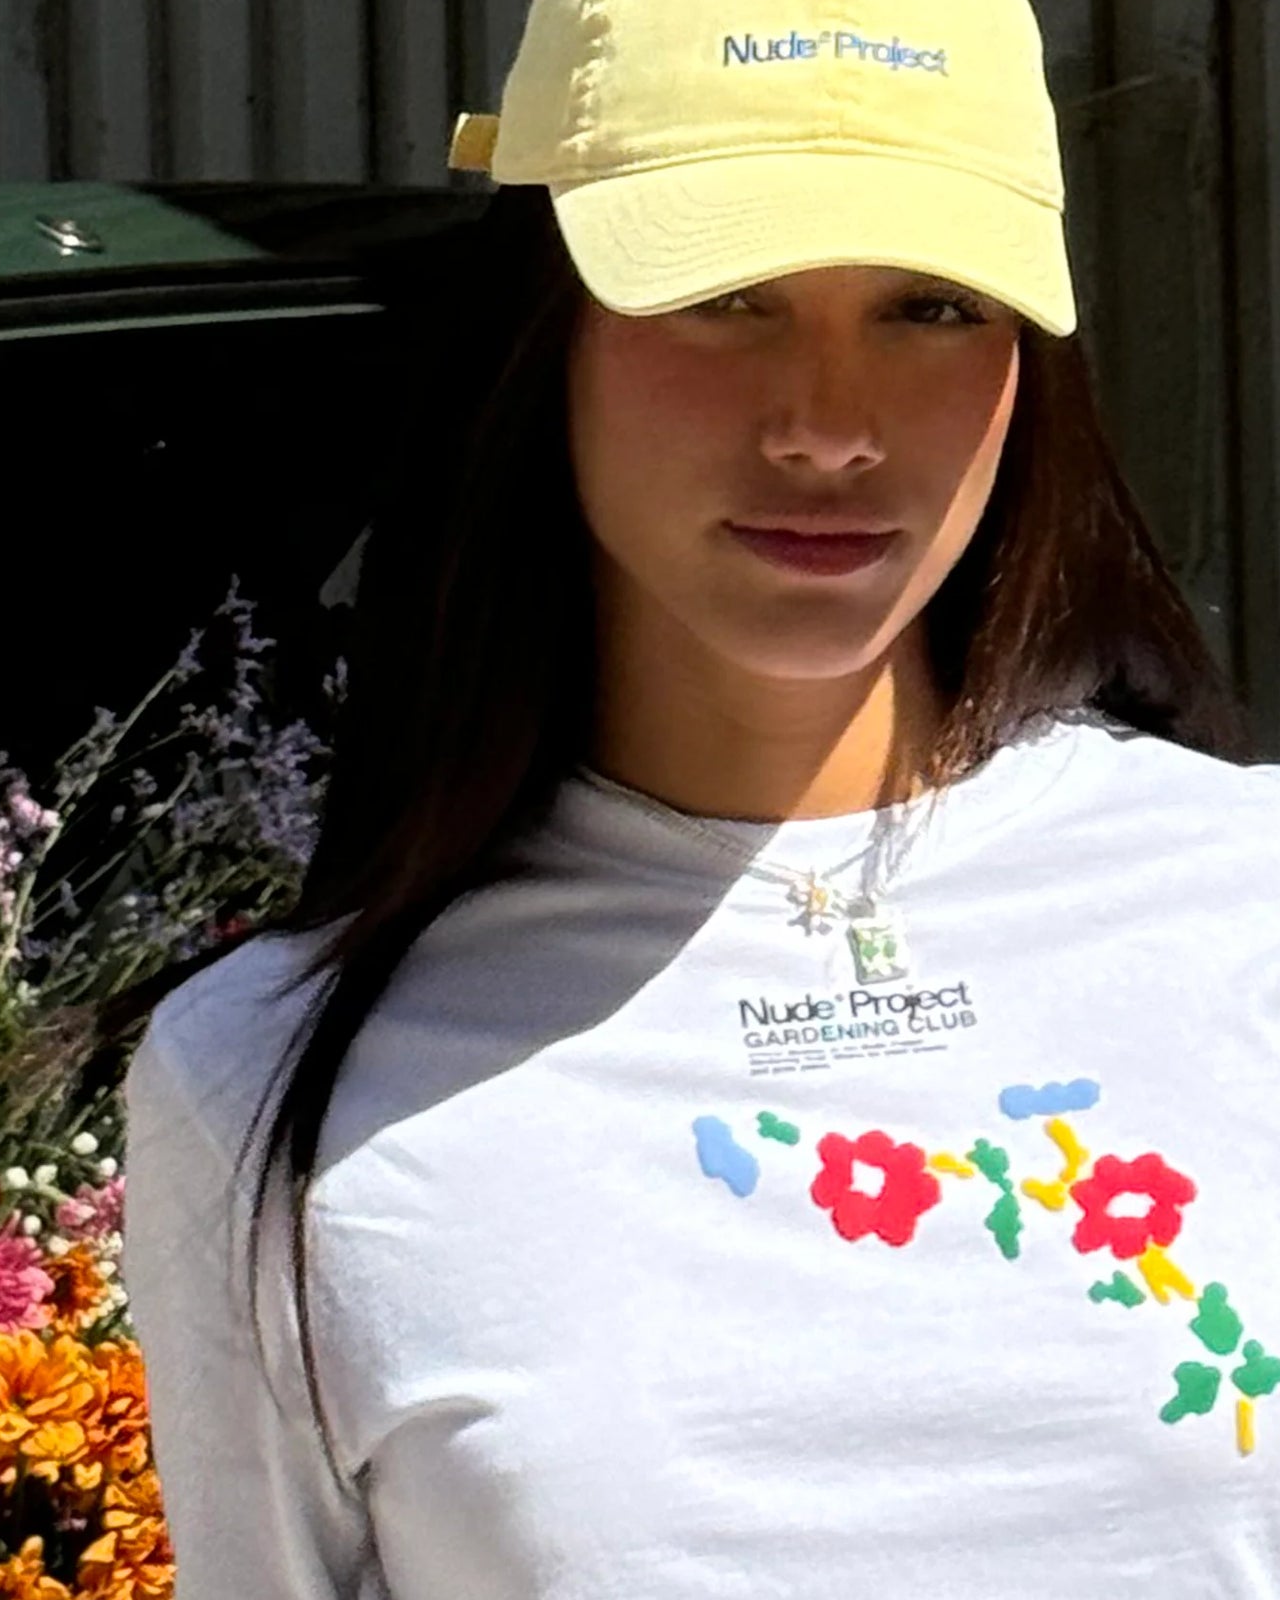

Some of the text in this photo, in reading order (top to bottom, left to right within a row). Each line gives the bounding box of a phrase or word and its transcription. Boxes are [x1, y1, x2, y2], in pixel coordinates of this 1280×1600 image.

[834, 31, 949, 77] Project
[849, 981, 973, 1022] Project
[743, 1010, 978, 1049] GARDENING CLUB
